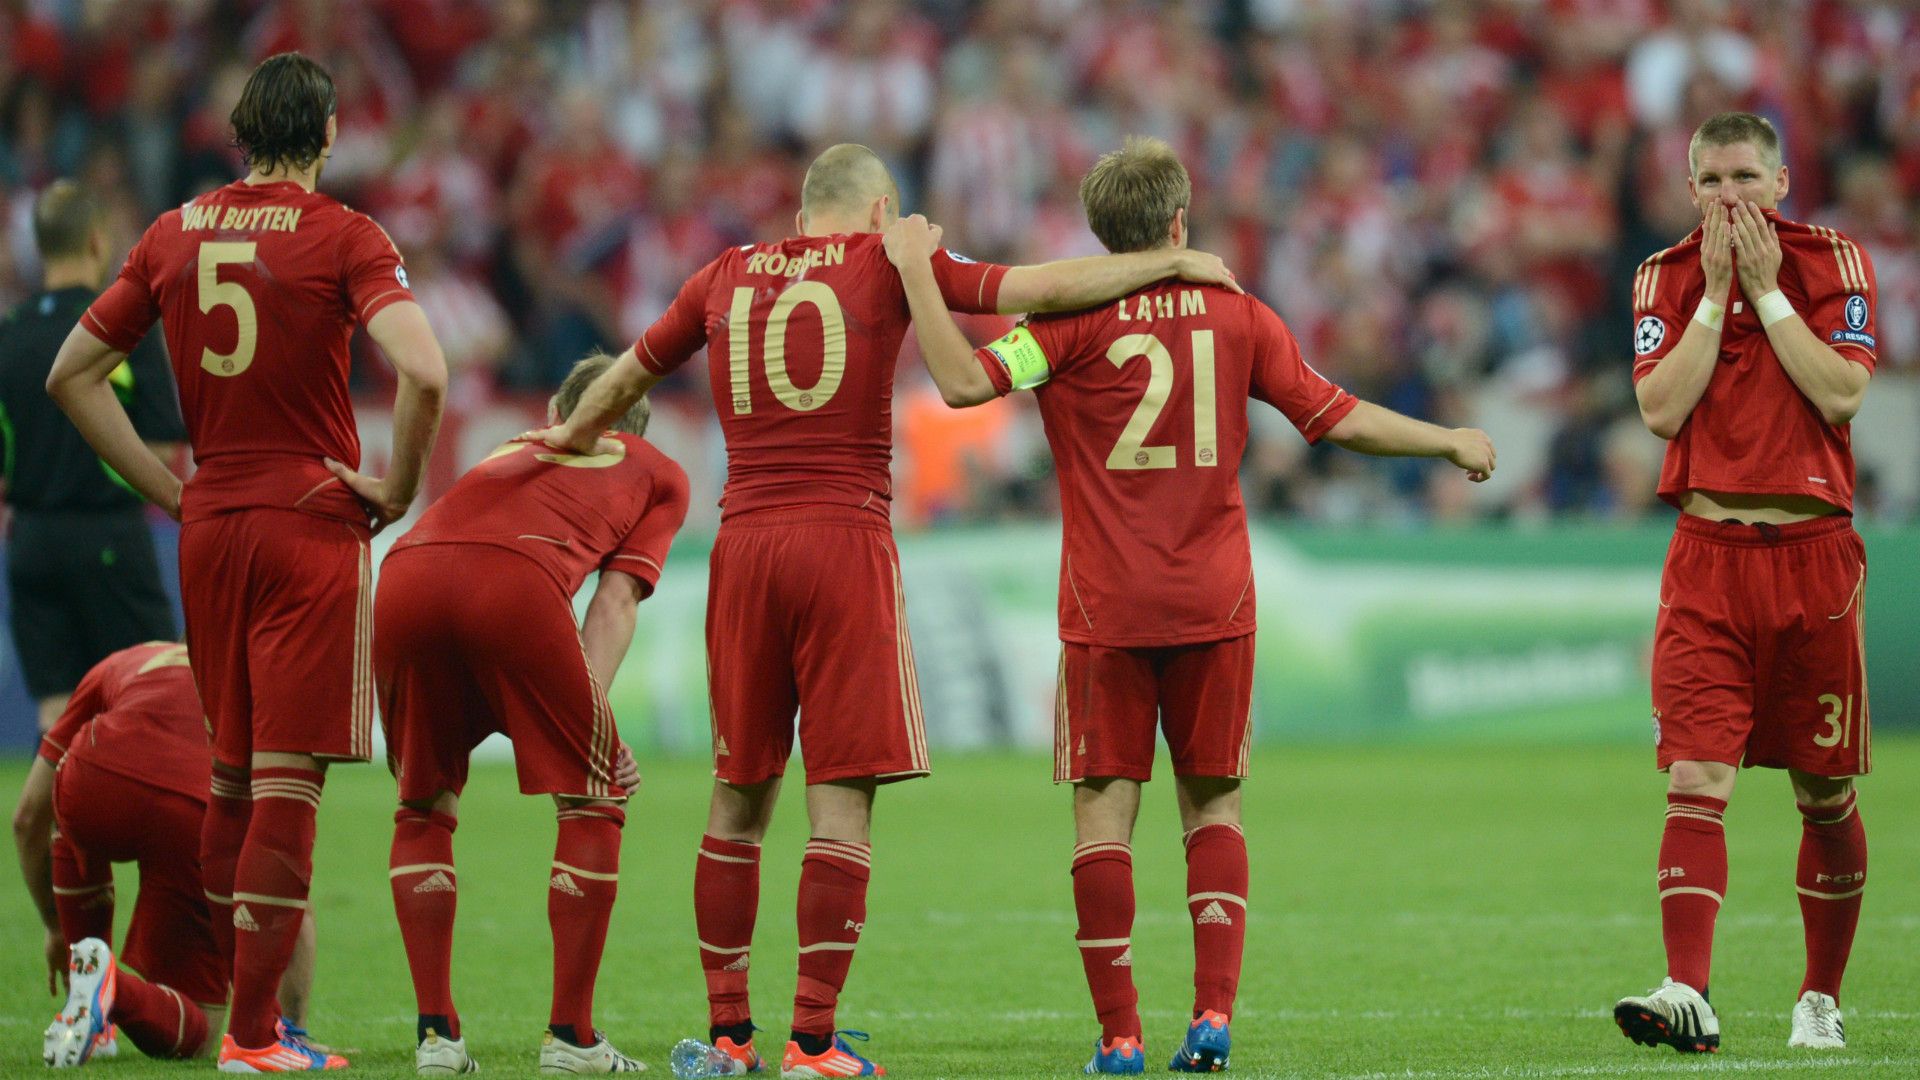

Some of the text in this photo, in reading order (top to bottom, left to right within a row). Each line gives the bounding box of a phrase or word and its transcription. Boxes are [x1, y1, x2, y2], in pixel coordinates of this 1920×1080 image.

[181, 204, 302, 233] VAN BUYTEN
[197, 241, 258, 377] 5
[1118, 289, 1207, 322] LAHM
[729, 280, 847, 415] 10
[1105, 329, 1218, 470] 21
[1813, 693, 1853, 749] 31
[1815, 871, 1864, 884] FCB
[1196, 914, 1232, 926] adidas
